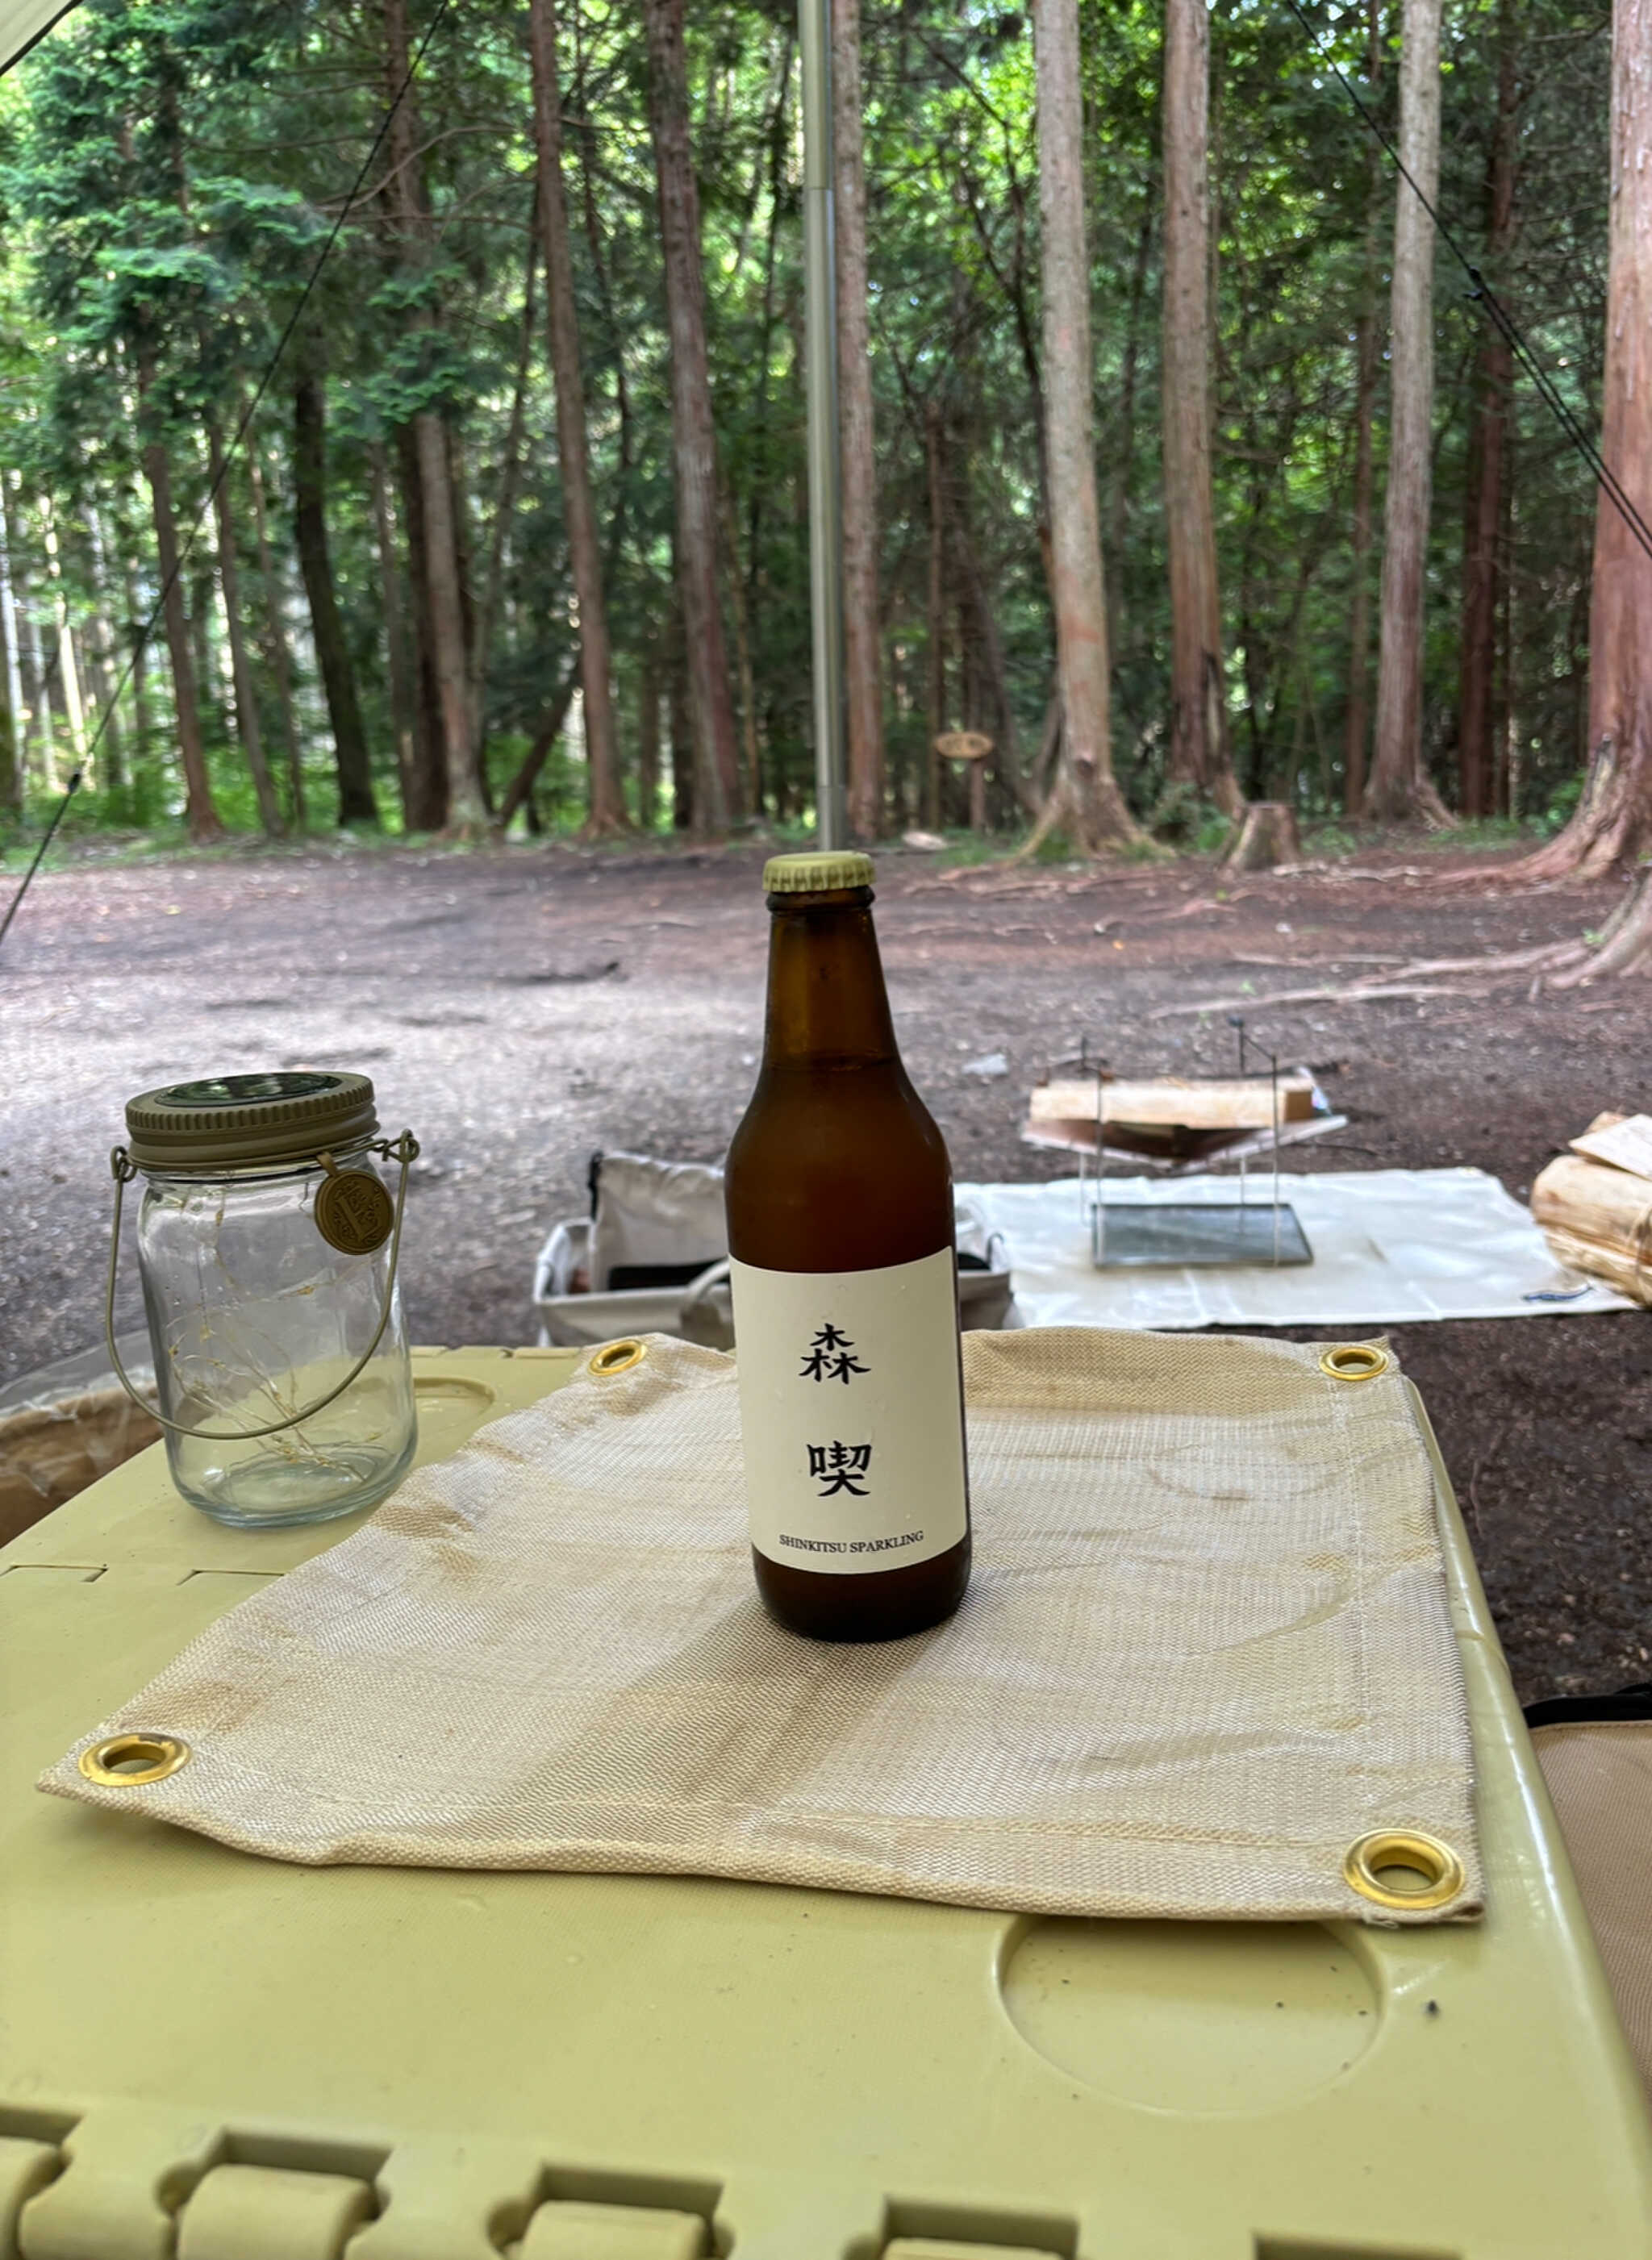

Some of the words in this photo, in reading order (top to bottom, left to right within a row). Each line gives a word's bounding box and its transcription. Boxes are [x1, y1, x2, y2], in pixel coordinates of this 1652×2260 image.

[799, 1322, 873, 1498] 森喫
[779, 1534, 847, 1553] SHINKITSU
[849, 1530, 924, 1553] SPARKLING
